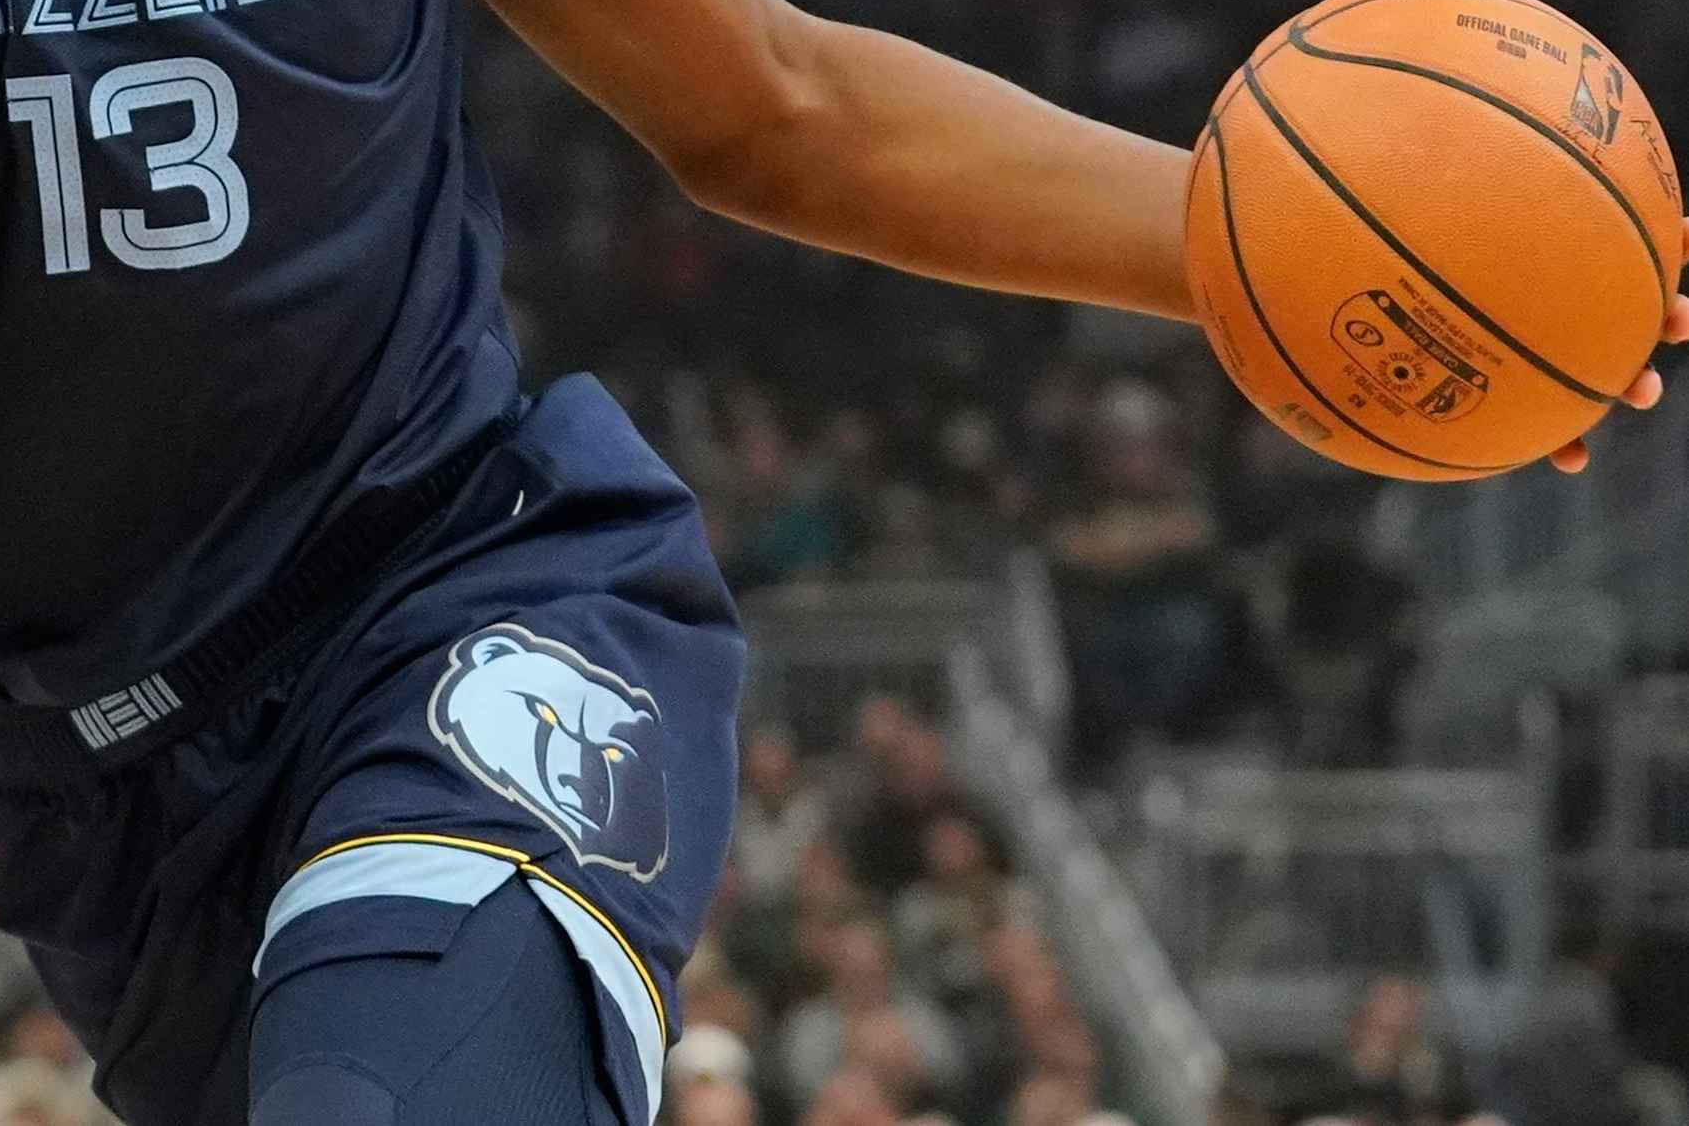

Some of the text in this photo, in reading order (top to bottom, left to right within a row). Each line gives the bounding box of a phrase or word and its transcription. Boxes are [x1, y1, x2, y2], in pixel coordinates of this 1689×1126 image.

[1456, 13, 1507, 38] OFFICIAL
[1508, 27, 1542, 51] GAME
[1541, 39, 1568, 65] BALL
[5, 56, 250, 275] 13
